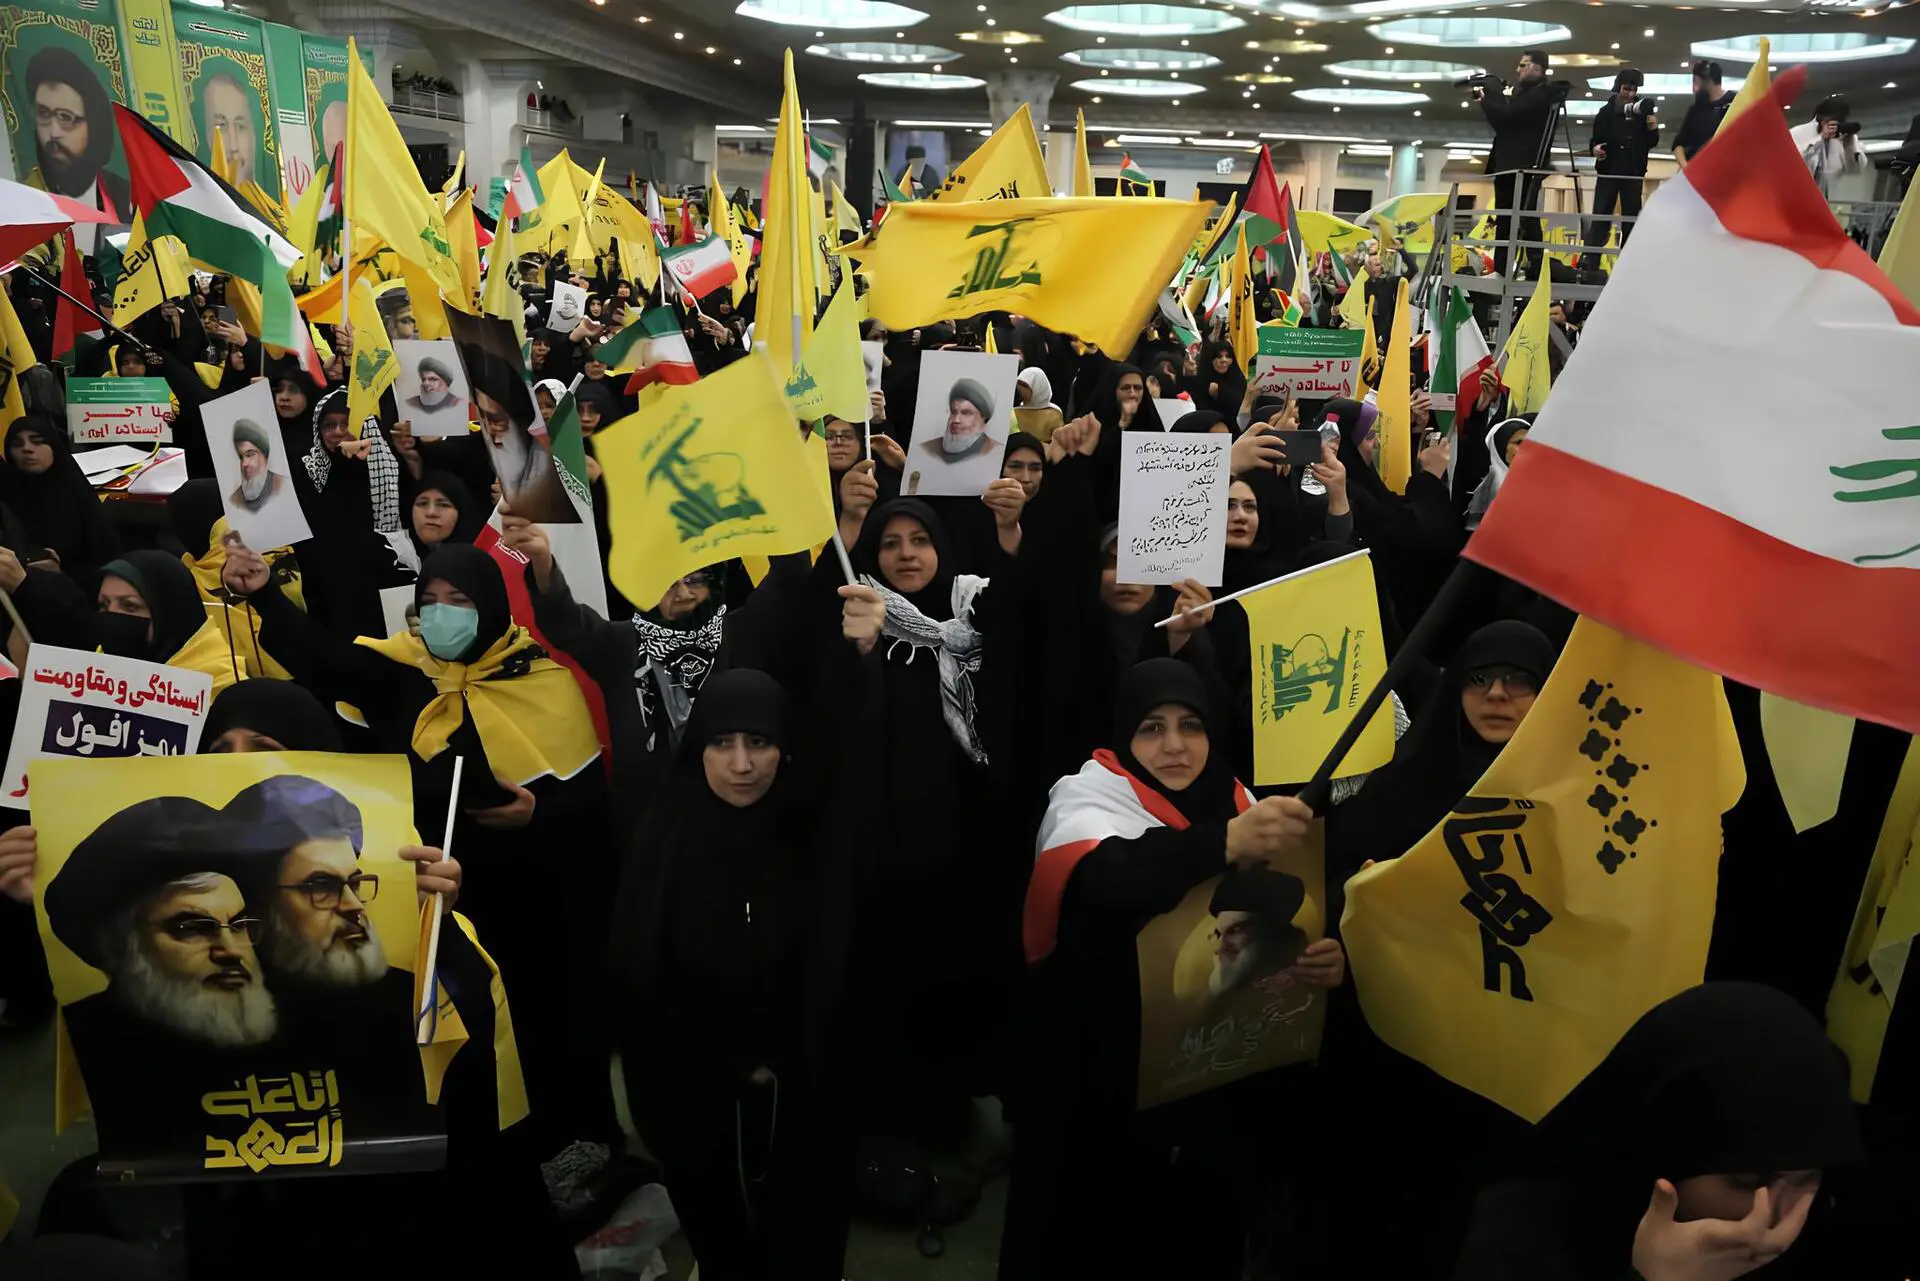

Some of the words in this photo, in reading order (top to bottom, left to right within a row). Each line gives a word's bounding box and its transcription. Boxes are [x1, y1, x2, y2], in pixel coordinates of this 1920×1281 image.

[34, 666, 114, 698] مقاومت
[115, 680, 128, 705] و
[129, 674, 205, 716] ایستادگی
[56, 711, 131, 755] افول
